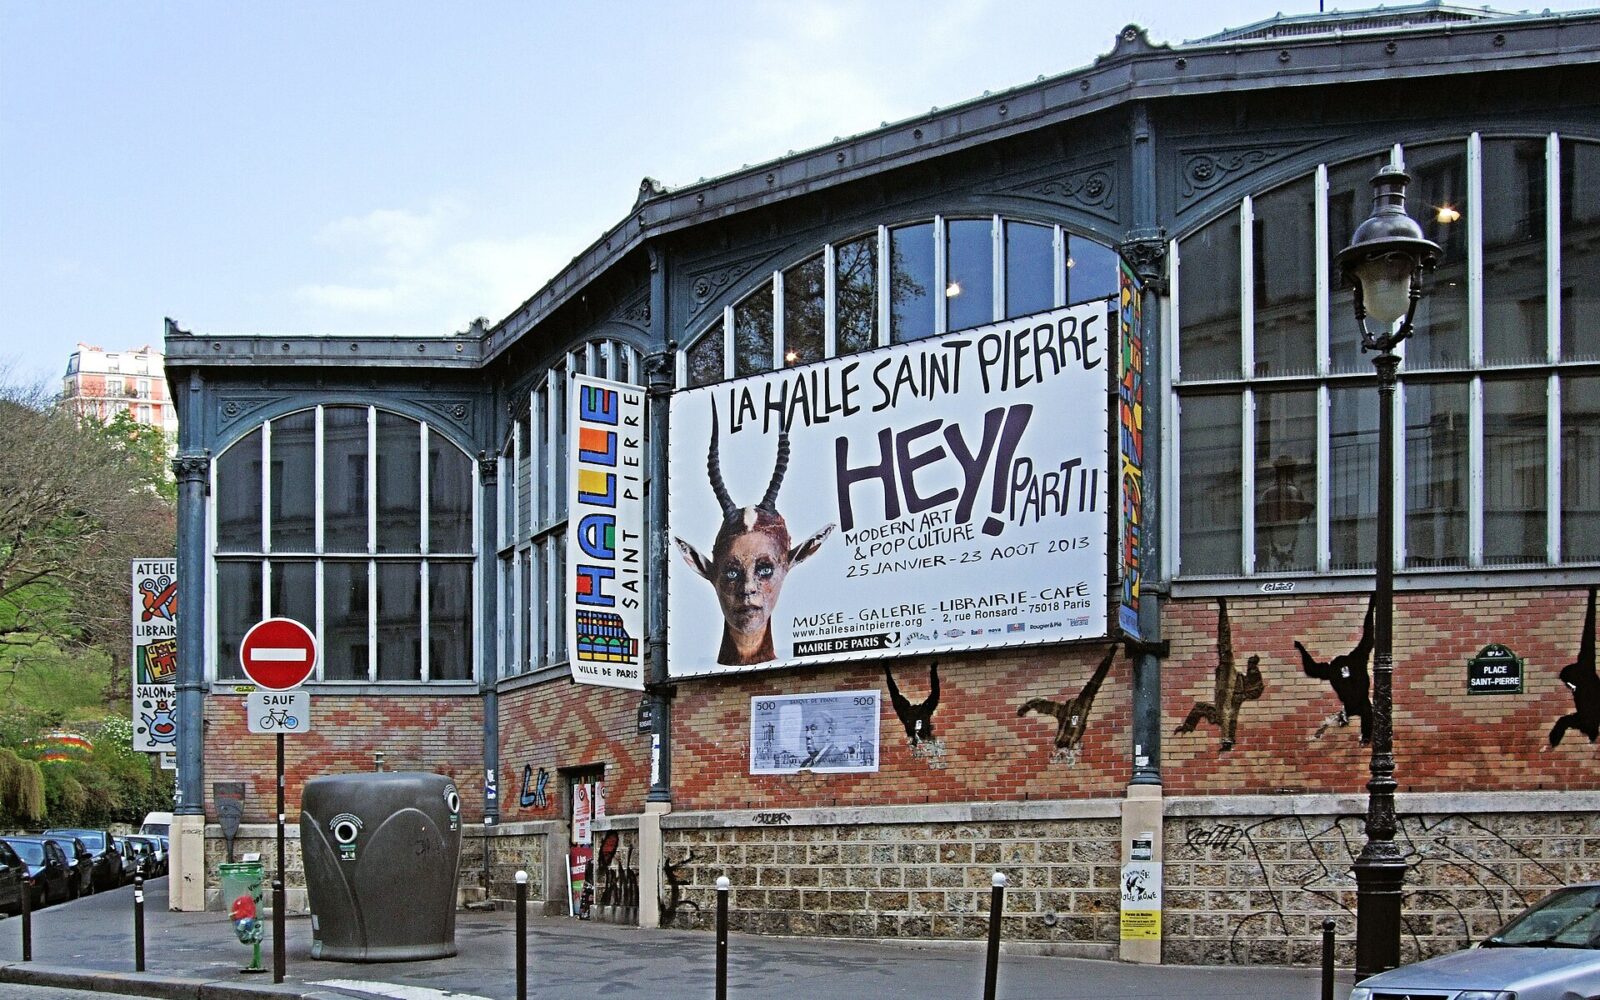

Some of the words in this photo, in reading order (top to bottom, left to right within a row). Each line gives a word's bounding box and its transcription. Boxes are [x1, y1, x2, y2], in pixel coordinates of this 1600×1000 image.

[731, 386, 757, 434] LA
[763, 363, 860, 434] HALLE
[873, 340, 972, 412] SAINT
[978, 315, 1102, 394] PIERRE
[624, 393, 639, 500] PIERRE
[835, 403, 1034, 537] HEY!
[576, 385, 618, 607] HALLE
[1010, 457, 1082, 526] PART
[845, 518, 914, 546] MODERN
[920, 509, 953, 533] ART
[854, 547, 867, 560] &
[870, 538, 905, 557] POP
[907, 523, 975, 550] CULTURE
[136, 563, 176, 575] ATELIE
[622, 530, 639, 609] SAINT
[846, 565, 870, 578] 25
[872, 555, 947, 575] JANVIER
[960, 550, 982, 564] 23
[1047, 536, 1090, 553] 2013
[792, 617, 923, 639] www.hallesaintpierre.org
[943, 613, 952, 624] 2,
[955, 612, 971, 622] rue
[975, 606, 1018, 620] Ronsard
[1029, 601, 1060, 614] 75018
[1063, 598, 1091, 610] Paris
[793, 611, 844, 629] MUSÉE
[859, 603, 926, 621] GALERIE
[940, 591, 1028, 612] LIBRAIRIE
[1040, 581, 1091, 600] CAFÉ
[136, 625, 177, 637] LIBRAIR
[798, 640, 833, 654] MAIRIE
[835, 639, 849, 650] DE
[851, 636, 879, 648] PARIS
[578, 665, 598, 675] VILLE
[602, 667, 612, 677] DE
[616, 670, 638, 680] PARIS
[1471, 677, 1520, 686] SAINT-PIERRE
[1483, 665, 1508, 674] PLACE
[136, 686, 167, 699] SALON
[263, 695, 295, 705] SAUF
[756, 701, 776, 711] 500
[853, 696, 874, 706] 500
